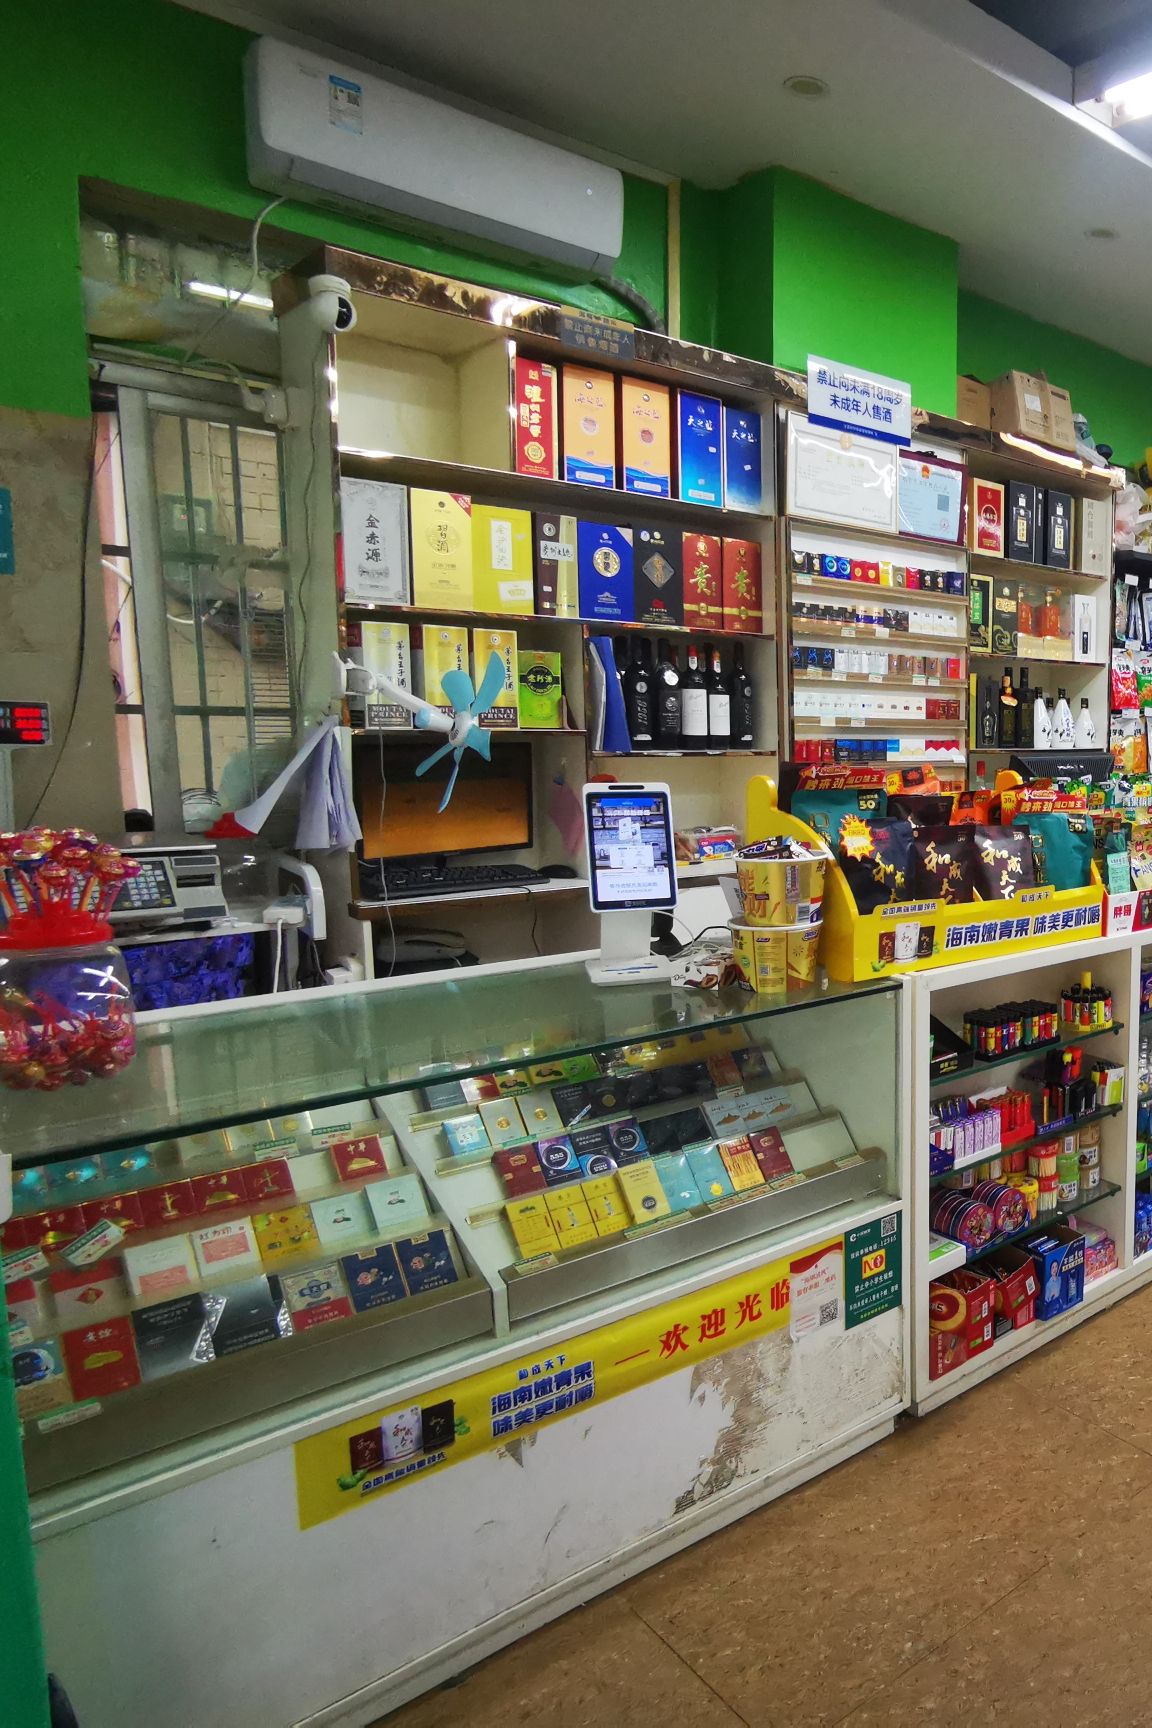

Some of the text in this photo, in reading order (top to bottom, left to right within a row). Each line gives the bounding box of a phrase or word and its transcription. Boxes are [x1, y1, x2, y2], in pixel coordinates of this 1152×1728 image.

[816, 368, 903, 406] 禁止向未满18周岁
[829, 393, 893, 424] 未成年人售酒
[364, 513, 382, 562] 金赤源
[455, 643, 463, 672] 茅台王
[480, 712, 516, 720] PRINCE
[944, 904, 1101, 949] 海南嫩青果 味美更耐嚼
[1113, 904, 1132, 919] 胖哥
[491, 1360, 595, 1416] 海南嫩青果
[492, 1382, 595, 1437] 味美更耐嚼
